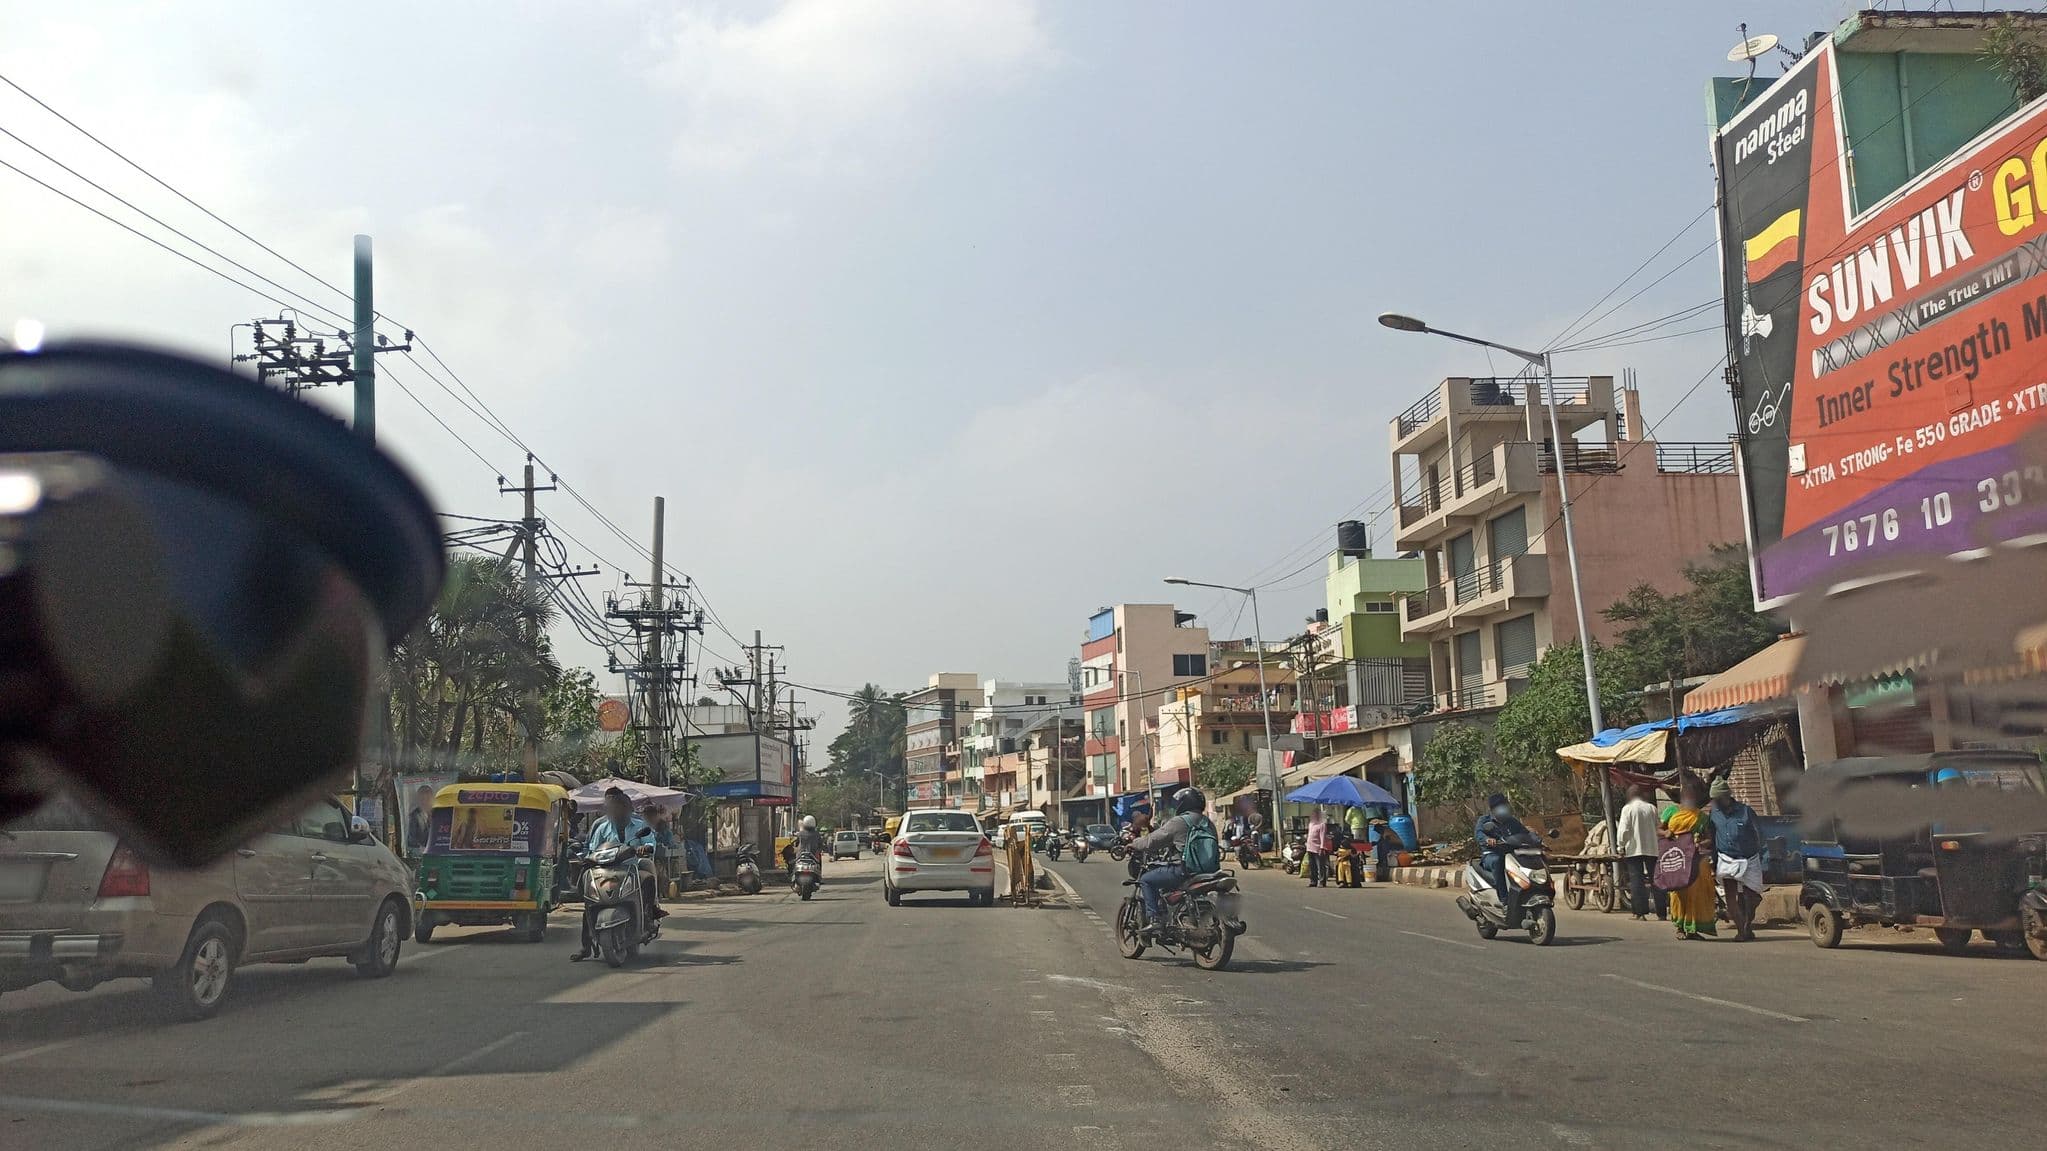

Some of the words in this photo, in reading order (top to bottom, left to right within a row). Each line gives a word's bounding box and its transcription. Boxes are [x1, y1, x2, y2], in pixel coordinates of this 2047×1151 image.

[1735, 88, 1808, 165] namma
[1808, 187, 1975, 336] SUNVIK
[1920, 299, 1946, 319] The
[1948, 282, 1980, 306] True
[1982, 260, 2013, 289] TMT
[1816, 379, 1874, 429] Inner
[1888, 318, 2011, 398] Strength
[1895, 436, 1913, 456] Fe
[1915, 422, 1945, 449] 550
[1949, 399, 2002, 437] GRADE
[1822, 508, 1899, 557] 7676
[1920, 491, 1952, 530] 10
[468, 791, 510, 801] zepto
